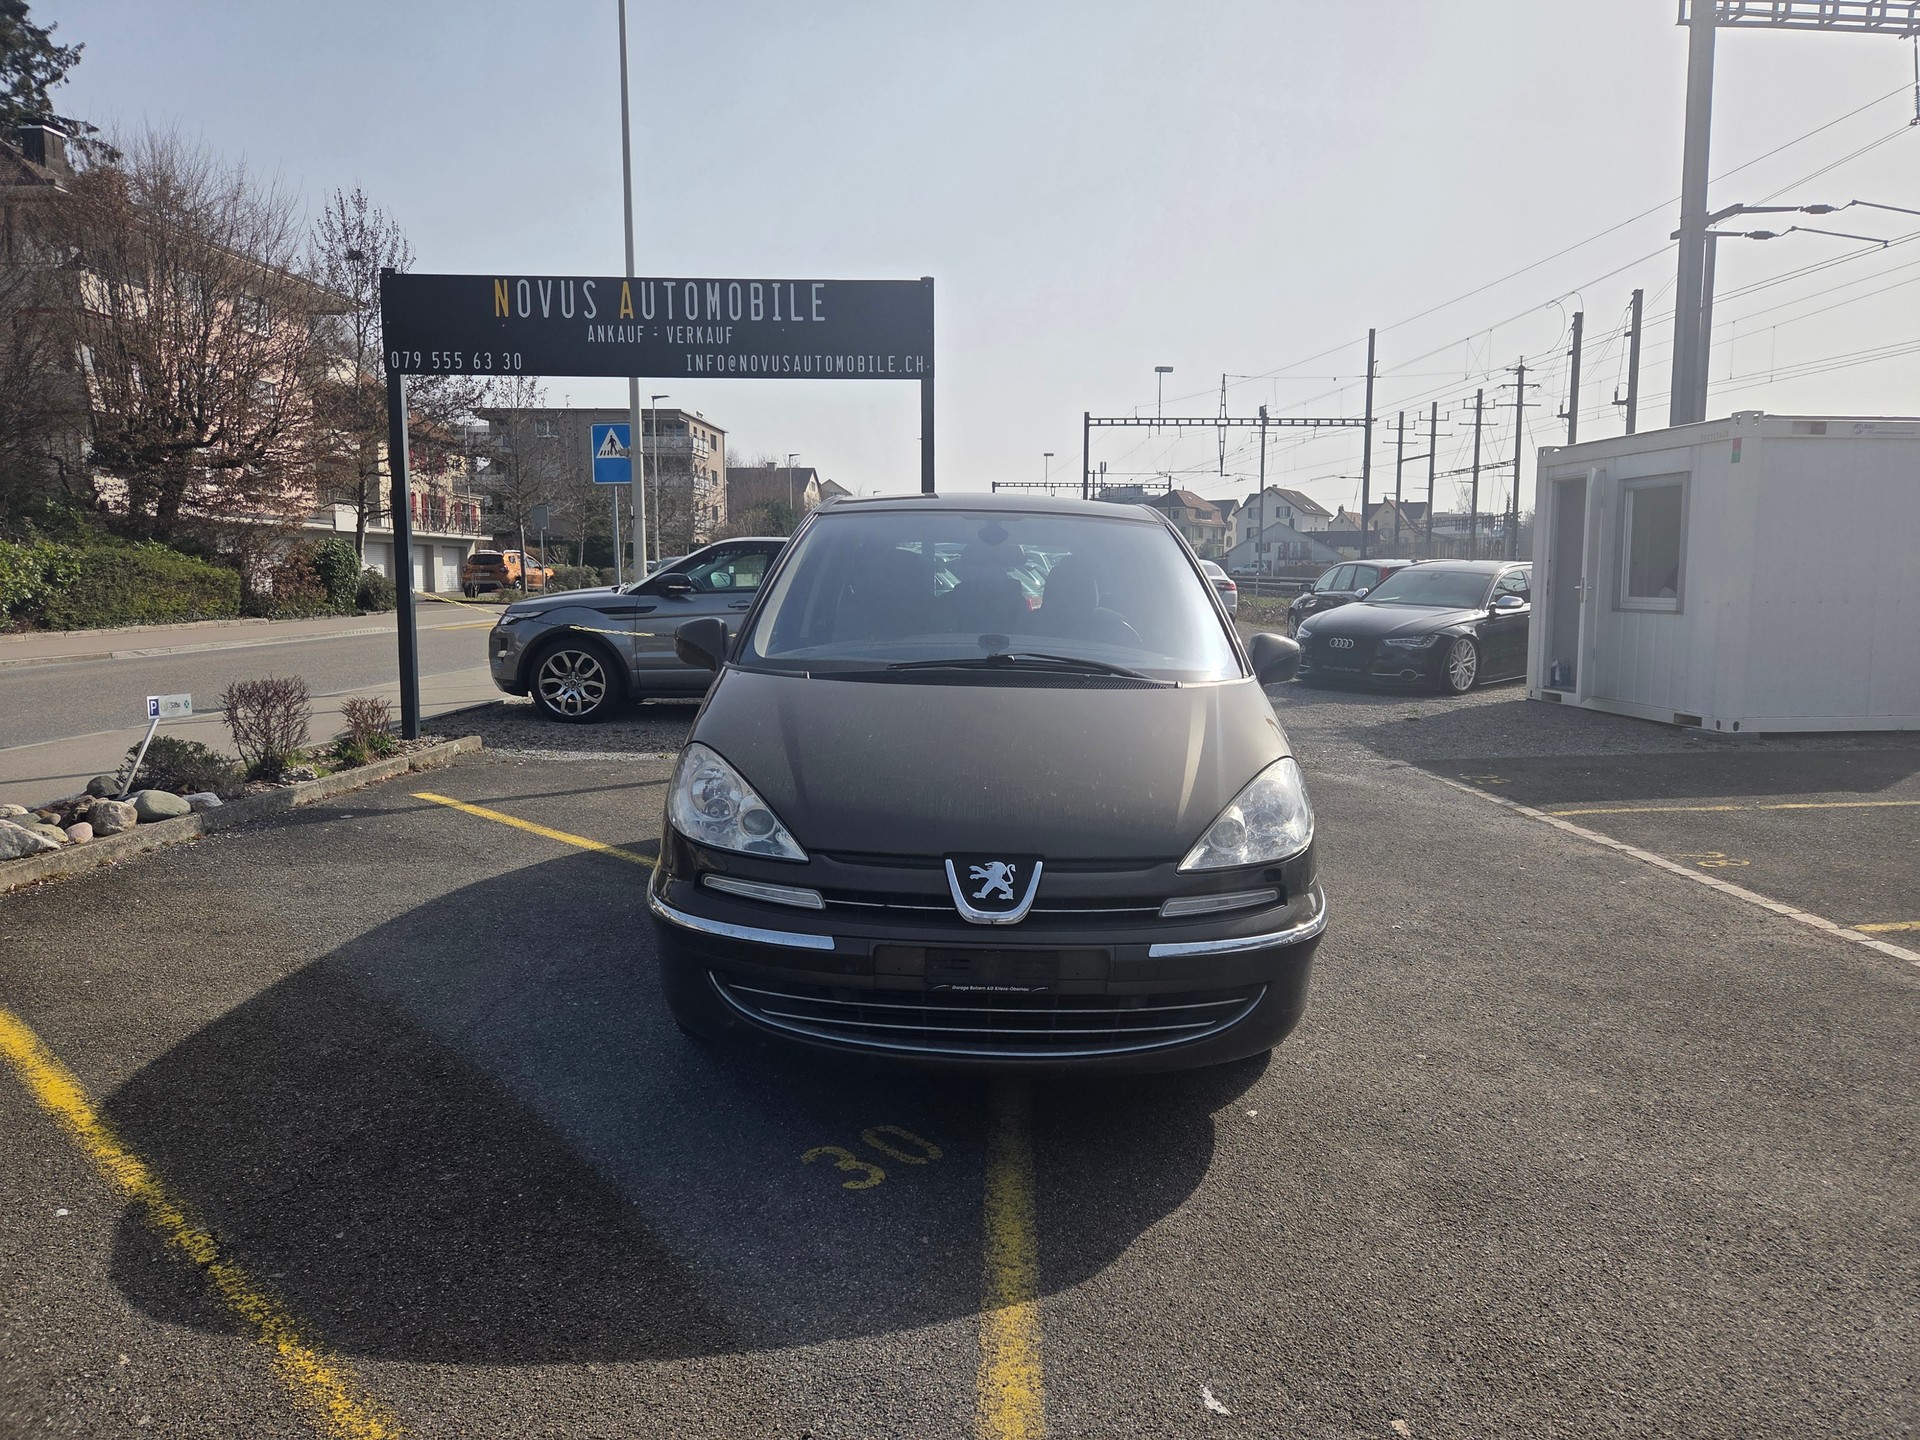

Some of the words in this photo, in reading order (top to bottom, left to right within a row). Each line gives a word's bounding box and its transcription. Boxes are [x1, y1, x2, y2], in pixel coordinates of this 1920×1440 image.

[494, 278, 597, 319] NOVUS
[619, 280, 826, 322] AUTOMOBILE
[587, 324, 645, 344] ANKAUF
[666, 325, 733, 345] VERKAUF
[391, 350, 422, 370] 079
[432, 351, 463, 370] 555
[473, 352, 493, 371] 63
[502, 352, 523, 371] 30
[686, 354, 925, 374] INFO@NOVUSAUTOMOBILE.CH
[150, 700, 157, 715] P
[800, 1124, 944, 1190] 30
